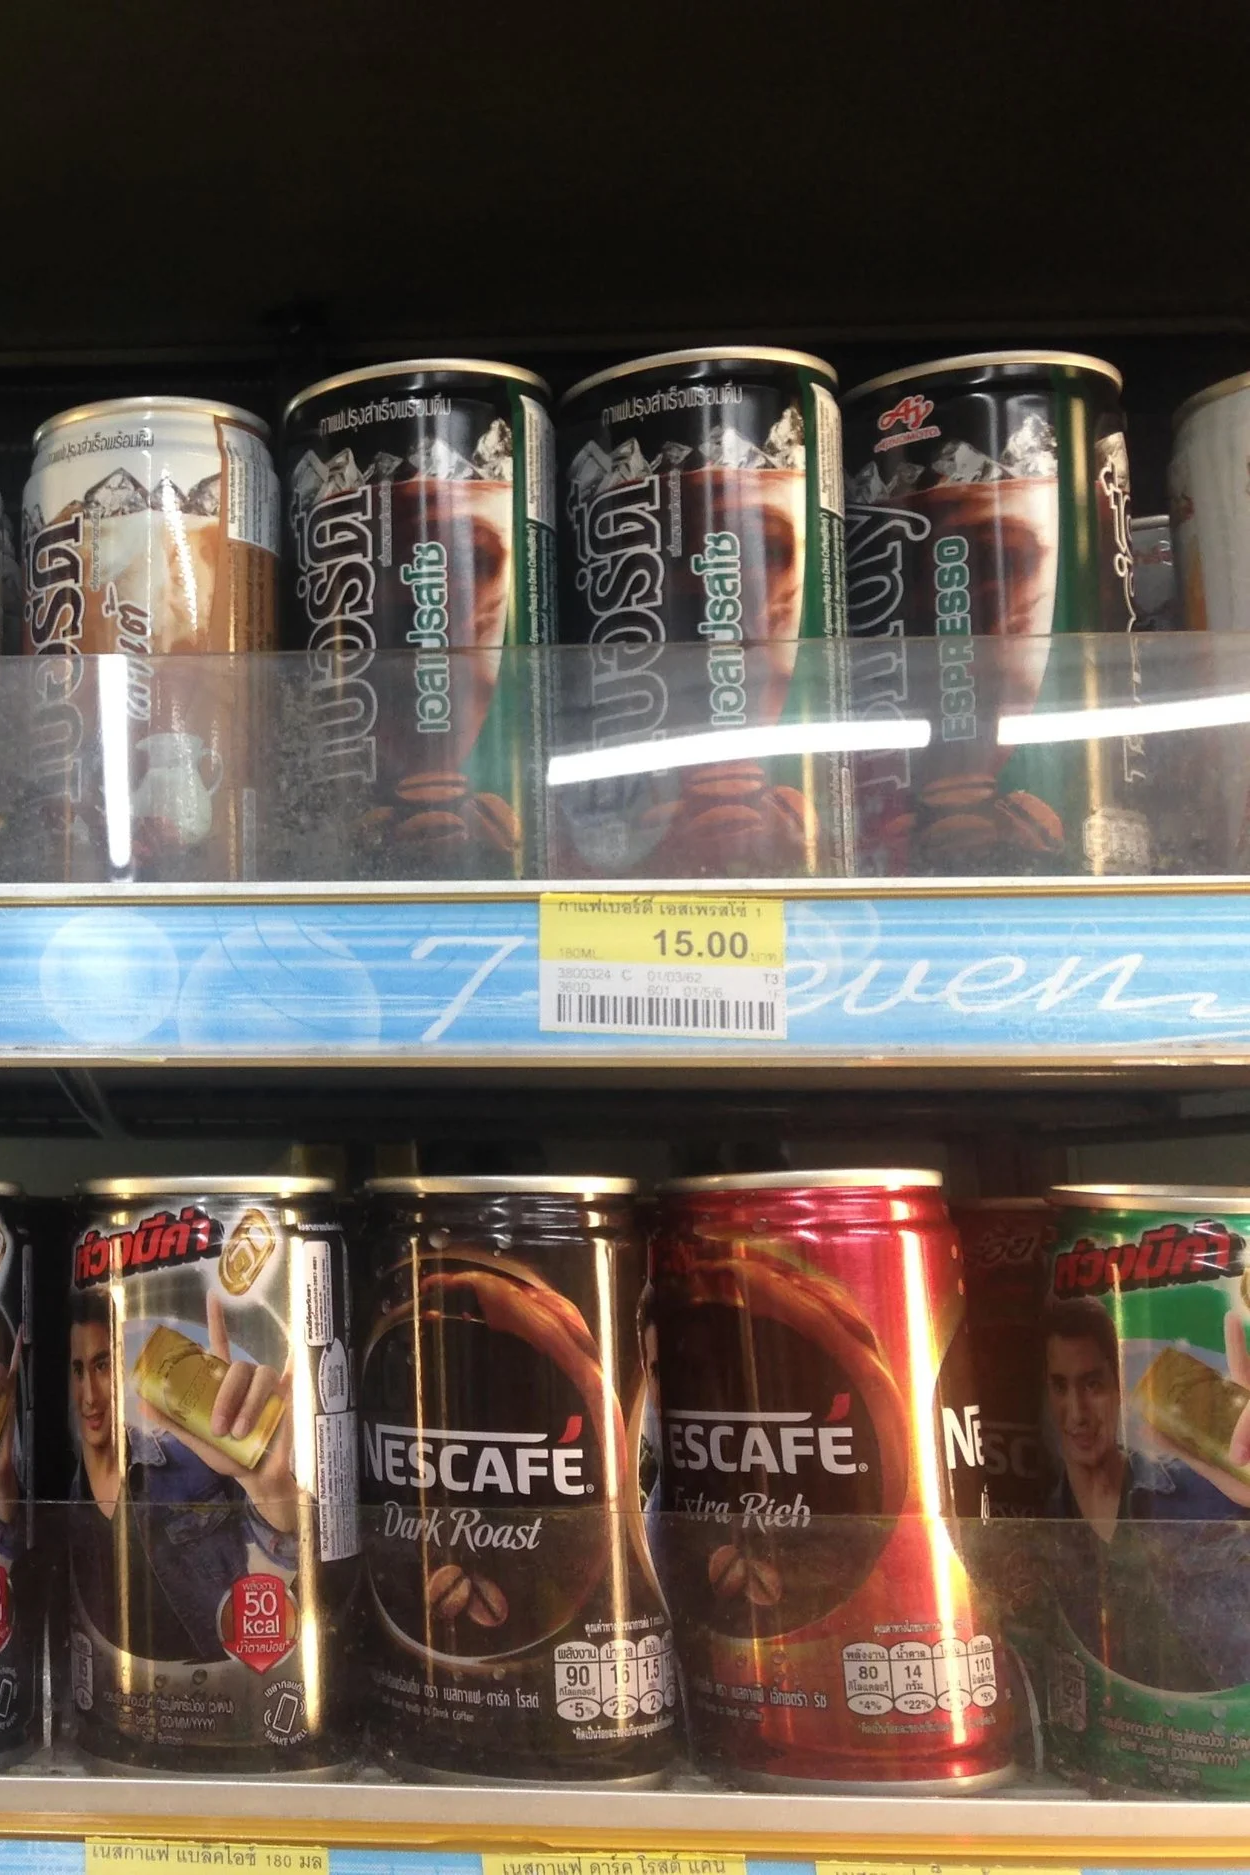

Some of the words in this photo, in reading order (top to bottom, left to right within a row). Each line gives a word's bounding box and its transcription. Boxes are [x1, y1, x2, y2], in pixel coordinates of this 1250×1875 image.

[933, 535, 977, 743] ESPRESSO
[653, 929, 748, 959] 15.00
[622, 970, 632, 981] C
[647, 970, 702, 984] 01/03/62
[763, 973, 779, 985] T3
[363, 1416, 586, 1497] NESCAFÉ
[740, 1492, 811, 1534] Rich
[383, 1501, 443, 1547] Dark
[451, 1507, 543, 1552] Roast
[244, 1591, 277, 1617] 50
[243, 1616, 280, 1634] kcal
[558, 1646, 597, 1660] พลังงาน
[845, 1646, 886, 1660] พลังงาน
[896, 1643, 925, 1659] น้ำตาล
[566, 1665, 590, 1687] 90
[610, 1663, 630, 1685] 16
[643, 1658, 661, 1681] 1.5
[858, 1665, 879, 1680] 80
[904, 1664, 922, 1680] 14
[974, 1655, 992, 1672] 110
[452, 1710, 475, 1722] Coffee
[264, 1729, 288, 1746] SHAKE
[92, 1842, 170, 1863] เนสกาแฟ
[265, 1853, 293, 1869] 180
[299, 1854, 324, 1871] มล
[502, 1857, 583, 1875] เนสกาแฟ
[588, 1854, 634, 1875] ดาร์ค
[638, 1853, 682, 1875] โรสต์
[688, 1858, 727, 1875] แคน
